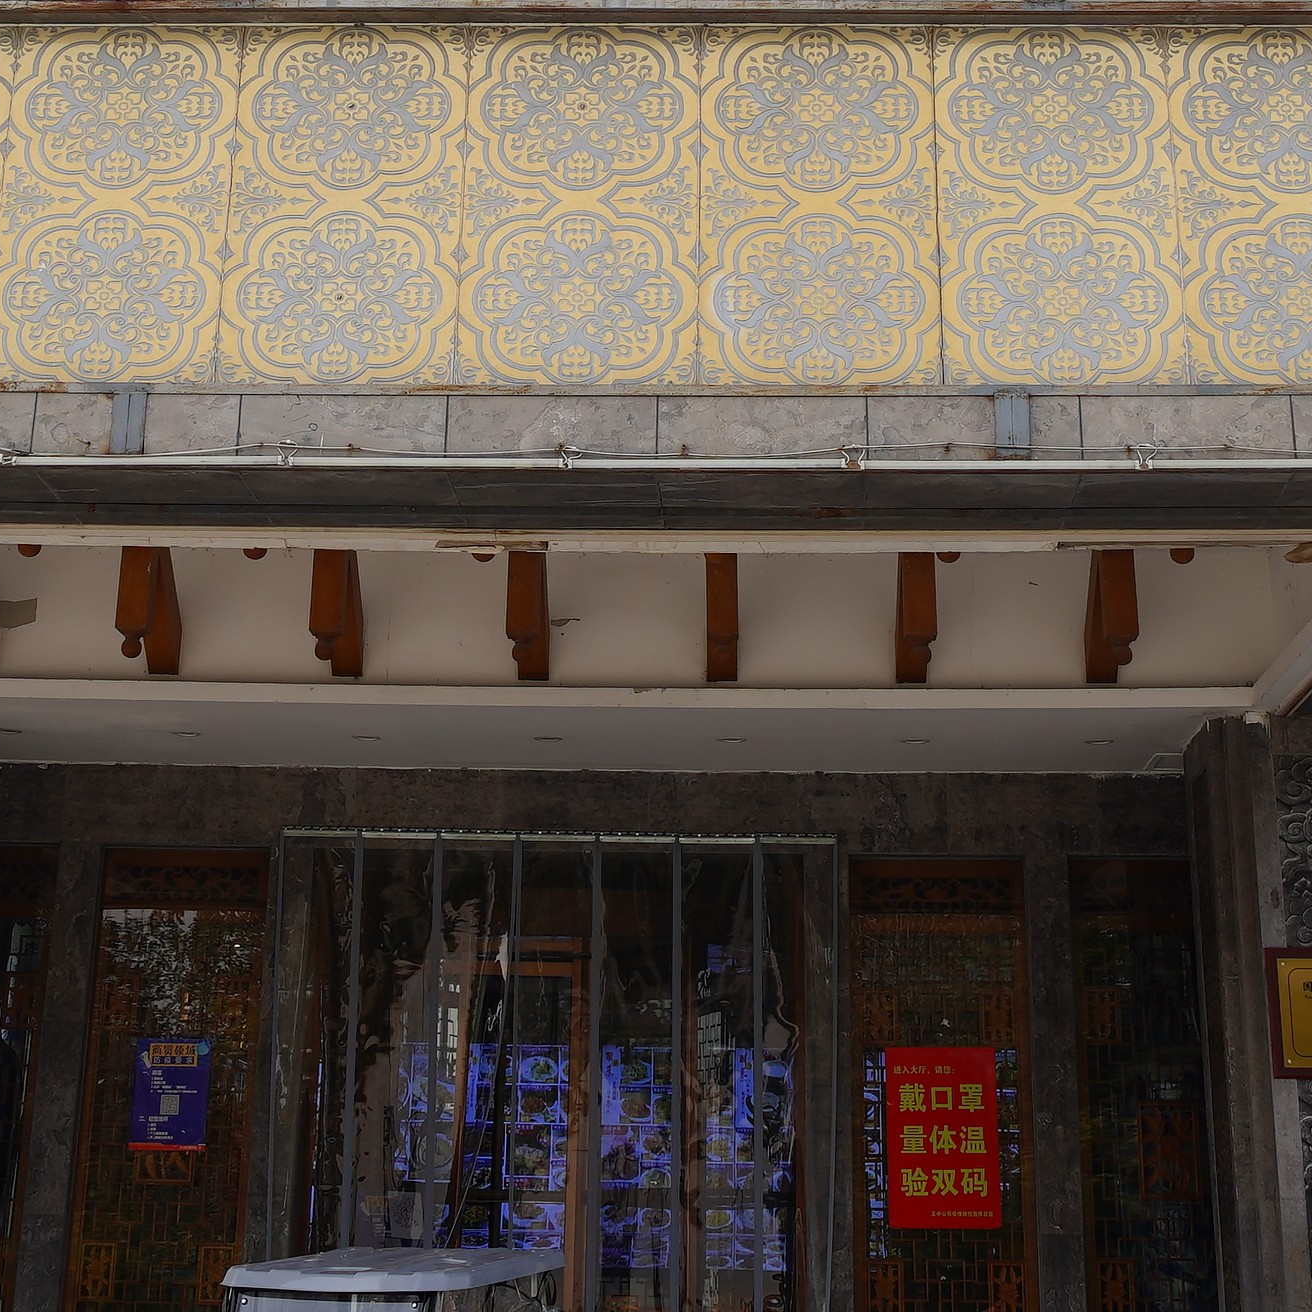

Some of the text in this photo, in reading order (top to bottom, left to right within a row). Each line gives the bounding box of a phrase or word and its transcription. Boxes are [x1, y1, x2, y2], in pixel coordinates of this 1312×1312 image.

[898, 1083, 985, 1113] 戴口罩
[899, 1124, 987, 1155] 量体温
[900, 1167, 988, 1197] 验双码
